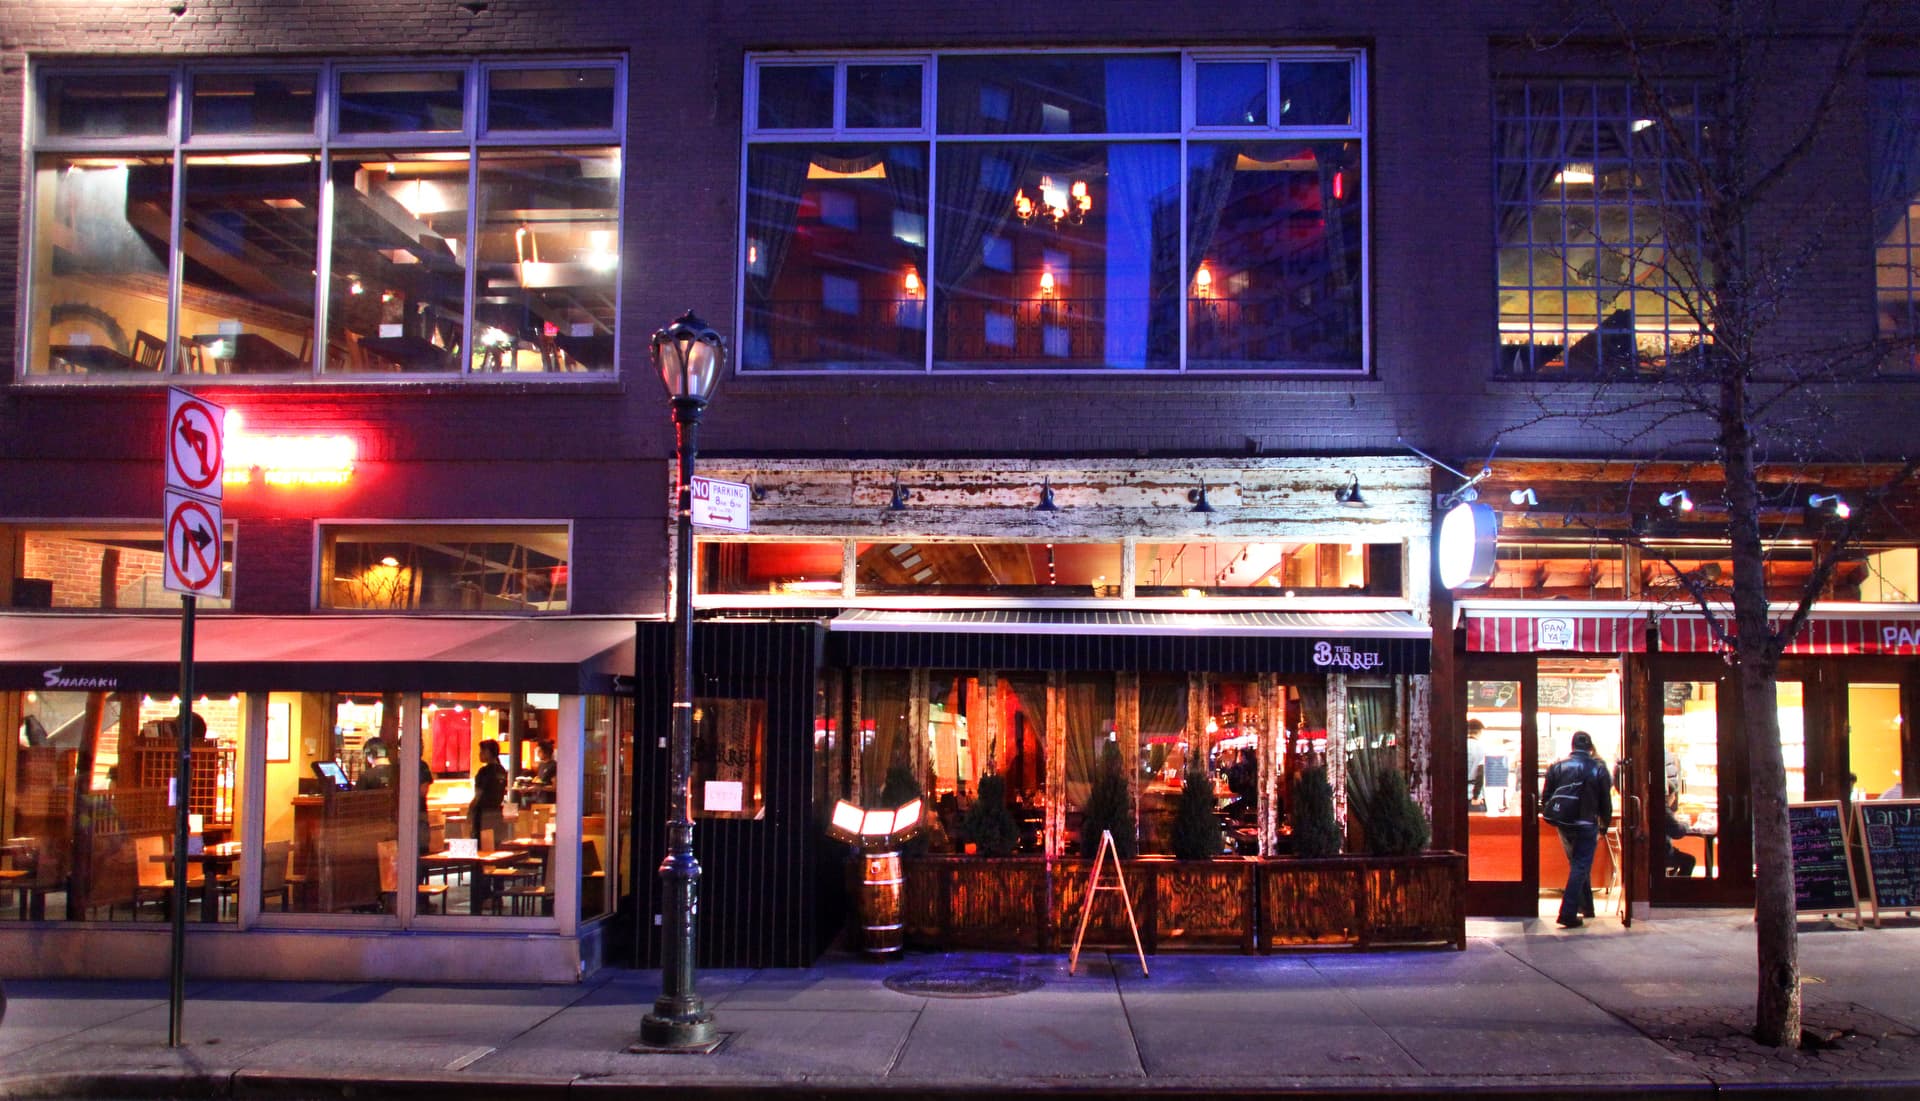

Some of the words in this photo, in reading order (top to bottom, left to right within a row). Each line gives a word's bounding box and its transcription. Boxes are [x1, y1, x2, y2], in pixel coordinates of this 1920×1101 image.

[693, 480, 709, 498] NO
[713, 485, 744, 498] PARKING
[1544, 624, 1563, 632] PAN
[1548, 633, 1558, 641] YA
[1313, 641, 1383, 669] BARREL
